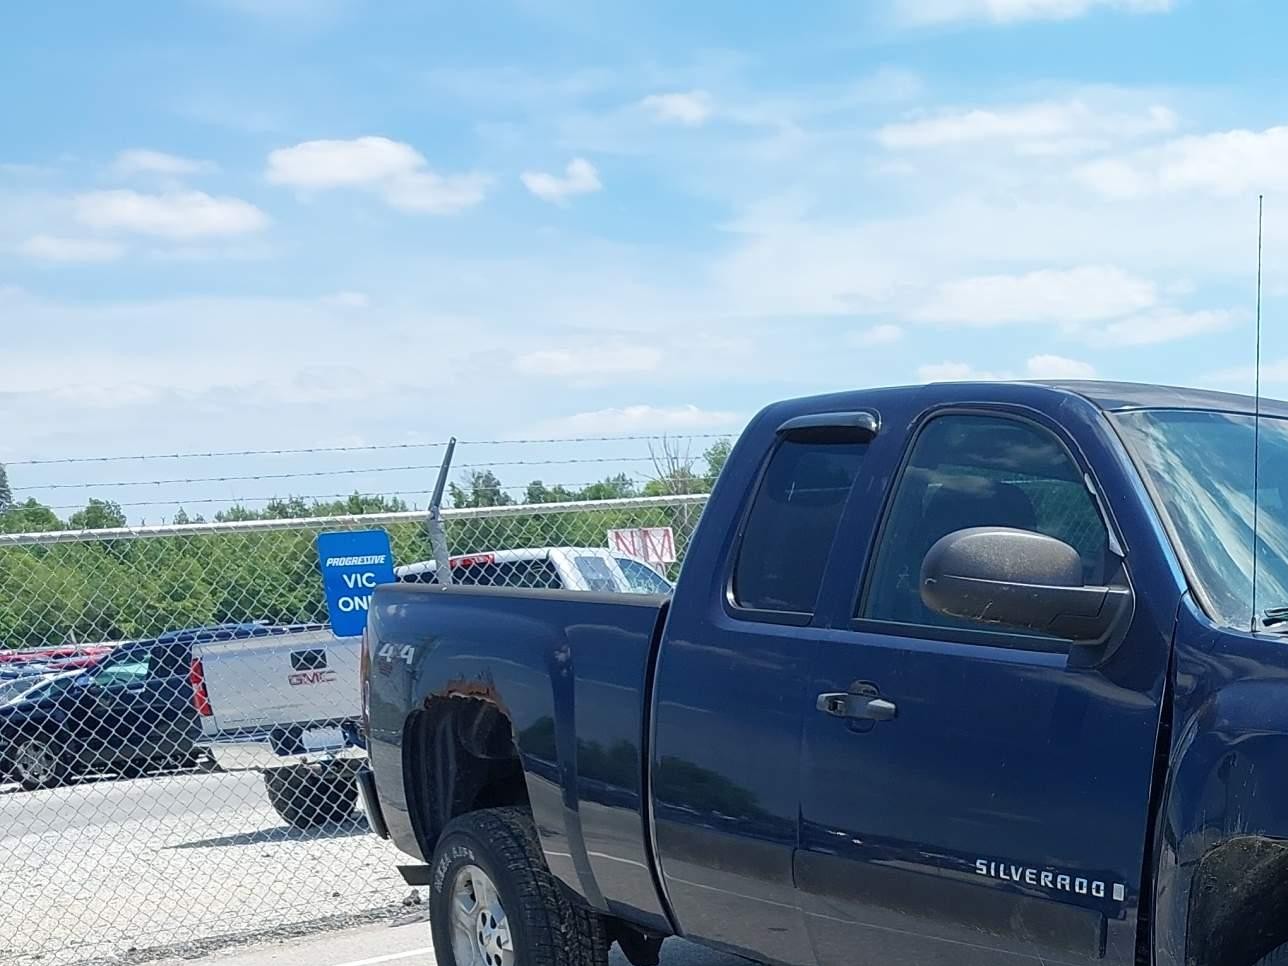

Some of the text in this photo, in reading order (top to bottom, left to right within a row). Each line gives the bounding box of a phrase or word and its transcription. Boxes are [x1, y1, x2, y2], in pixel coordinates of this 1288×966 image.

[326, 554, 387, 567] PROGRESSIVE
[342, 572, 377, 589] VIC
[288, 670, 337, 686] GMC
[975, 859, 1105, 898] SILVERADO
